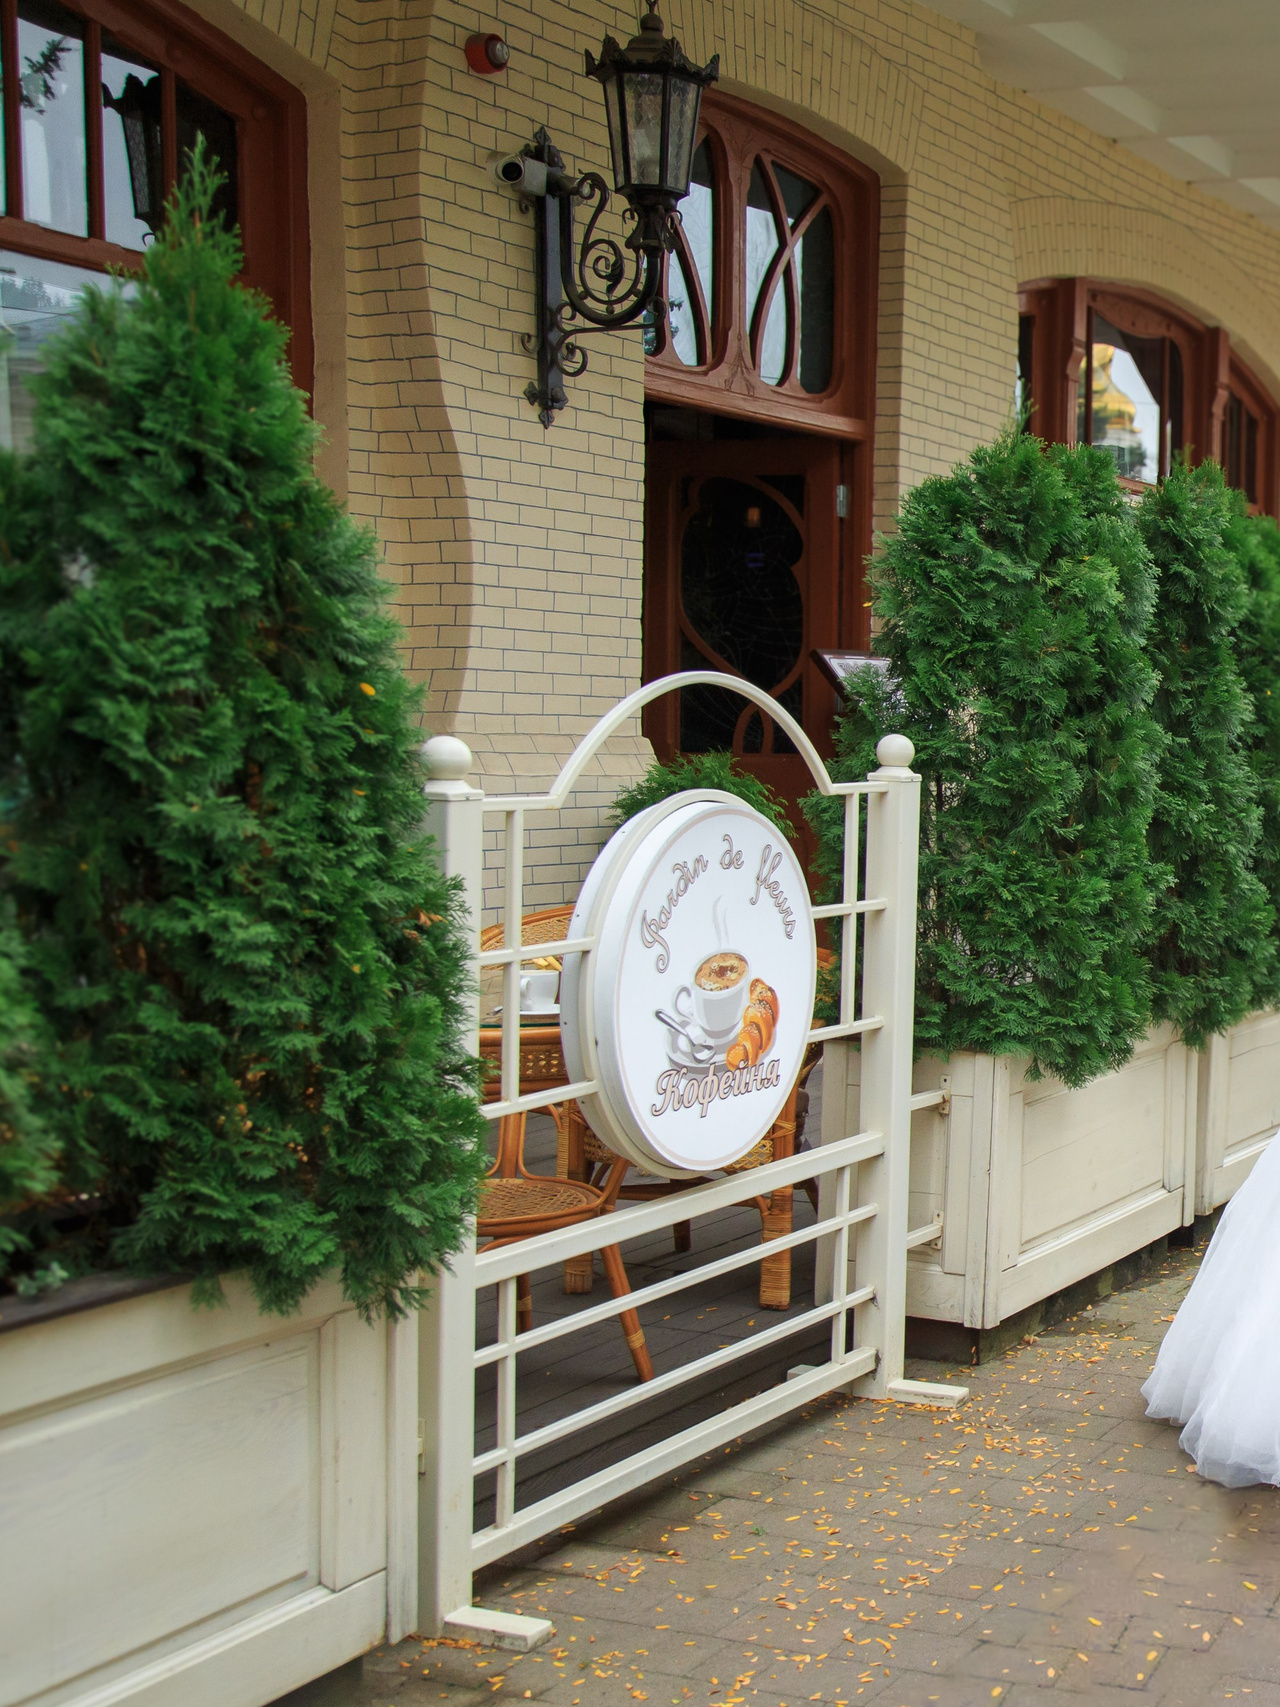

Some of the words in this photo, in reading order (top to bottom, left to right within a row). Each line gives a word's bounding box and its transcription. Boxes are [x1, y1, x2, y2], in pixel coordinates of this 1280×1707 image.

[641, 854, 709, 973] Jardin
[720, 833, 744, 869] de
[749, 844, 796, 939] fleurs
[651, 1059, 780, 1118] Кофейня
